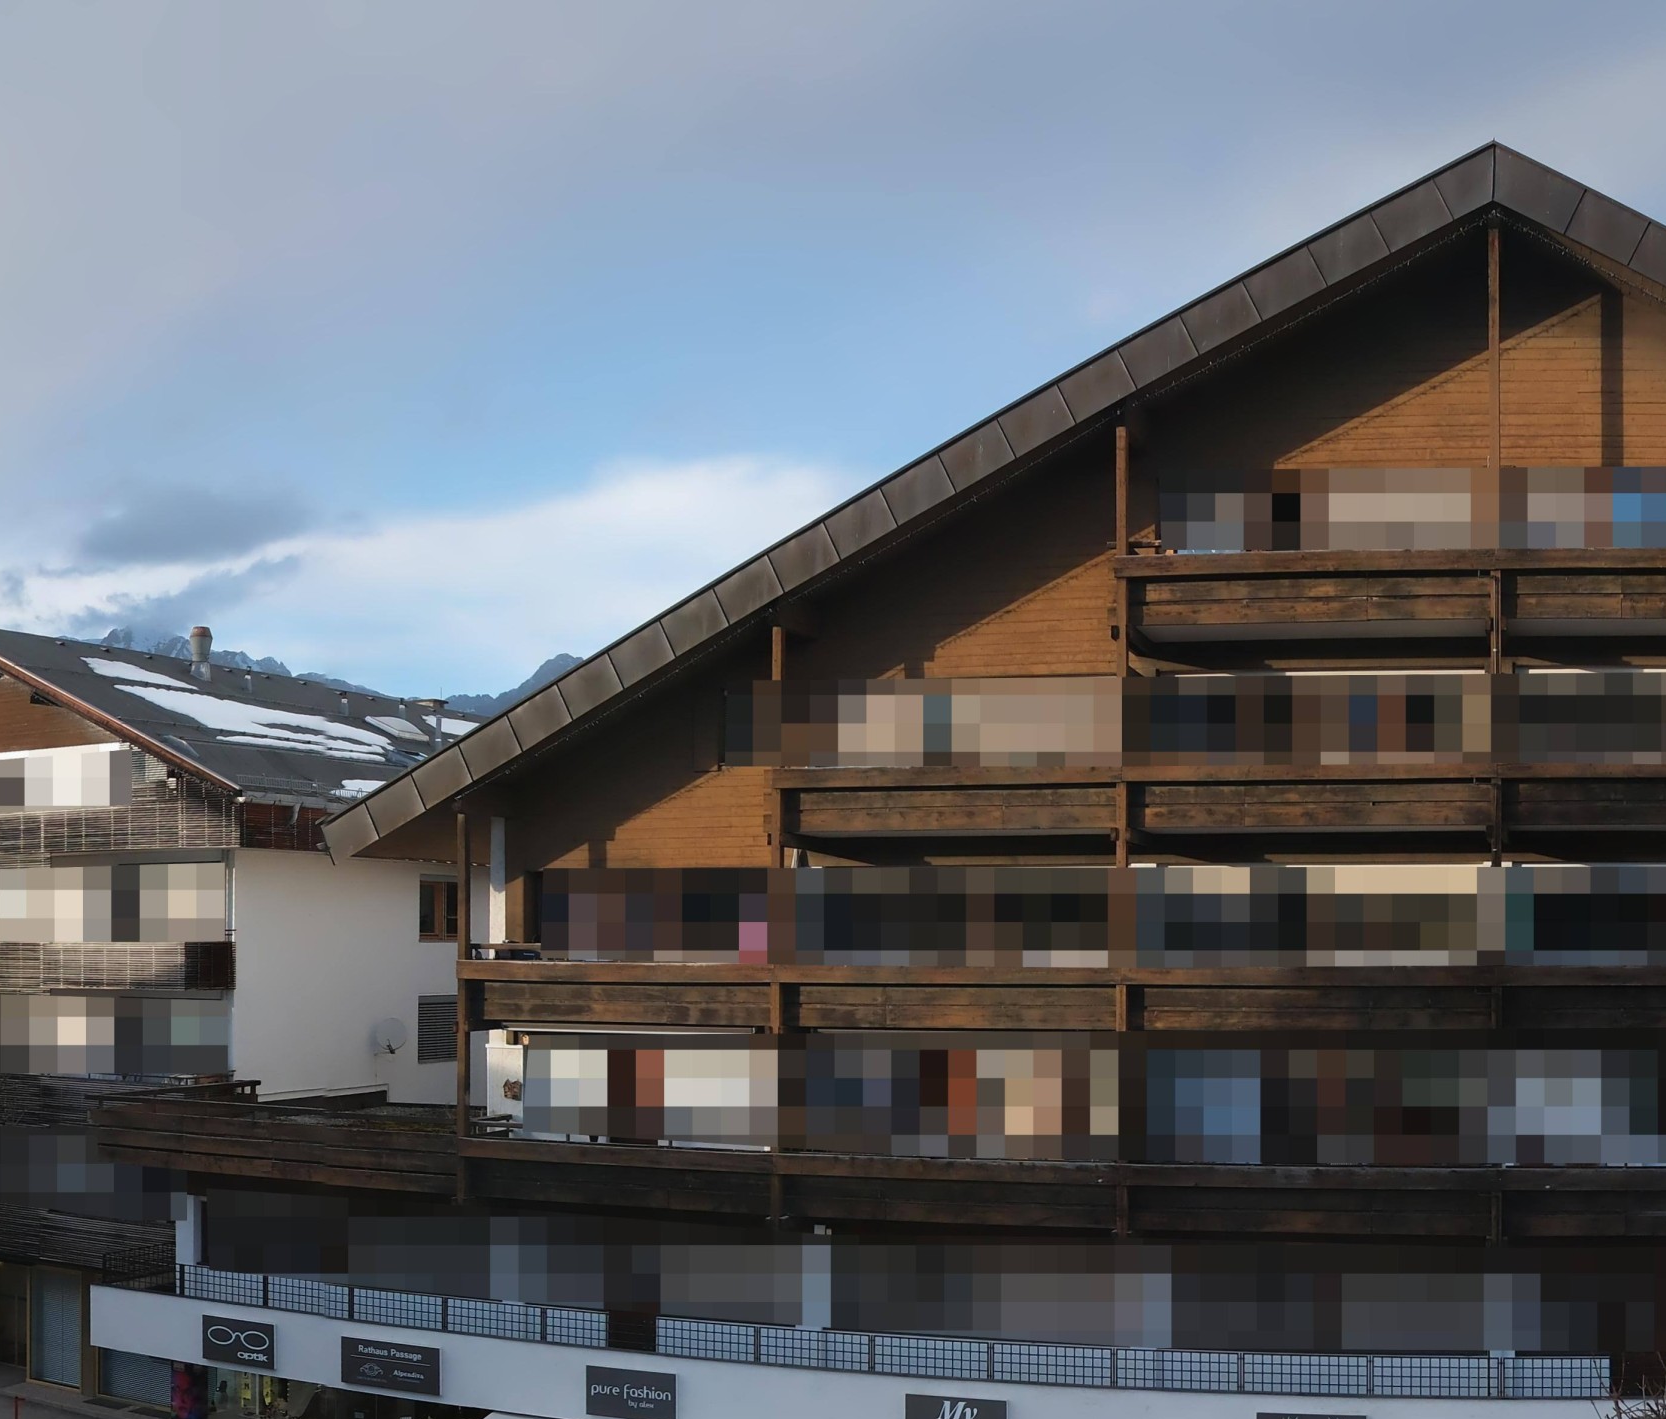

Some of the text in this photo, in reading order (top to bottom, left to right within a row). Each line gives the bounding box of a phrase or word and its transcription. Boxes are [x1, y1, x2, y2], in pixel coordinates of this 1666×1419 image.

[237, 1351, 269, 1362] optik
[358, 1344, 422, 1361] Rathaus Passage
[590, 1383, 672, 1401] pure fashion
[628, 1399, 654, 1409] by alex
